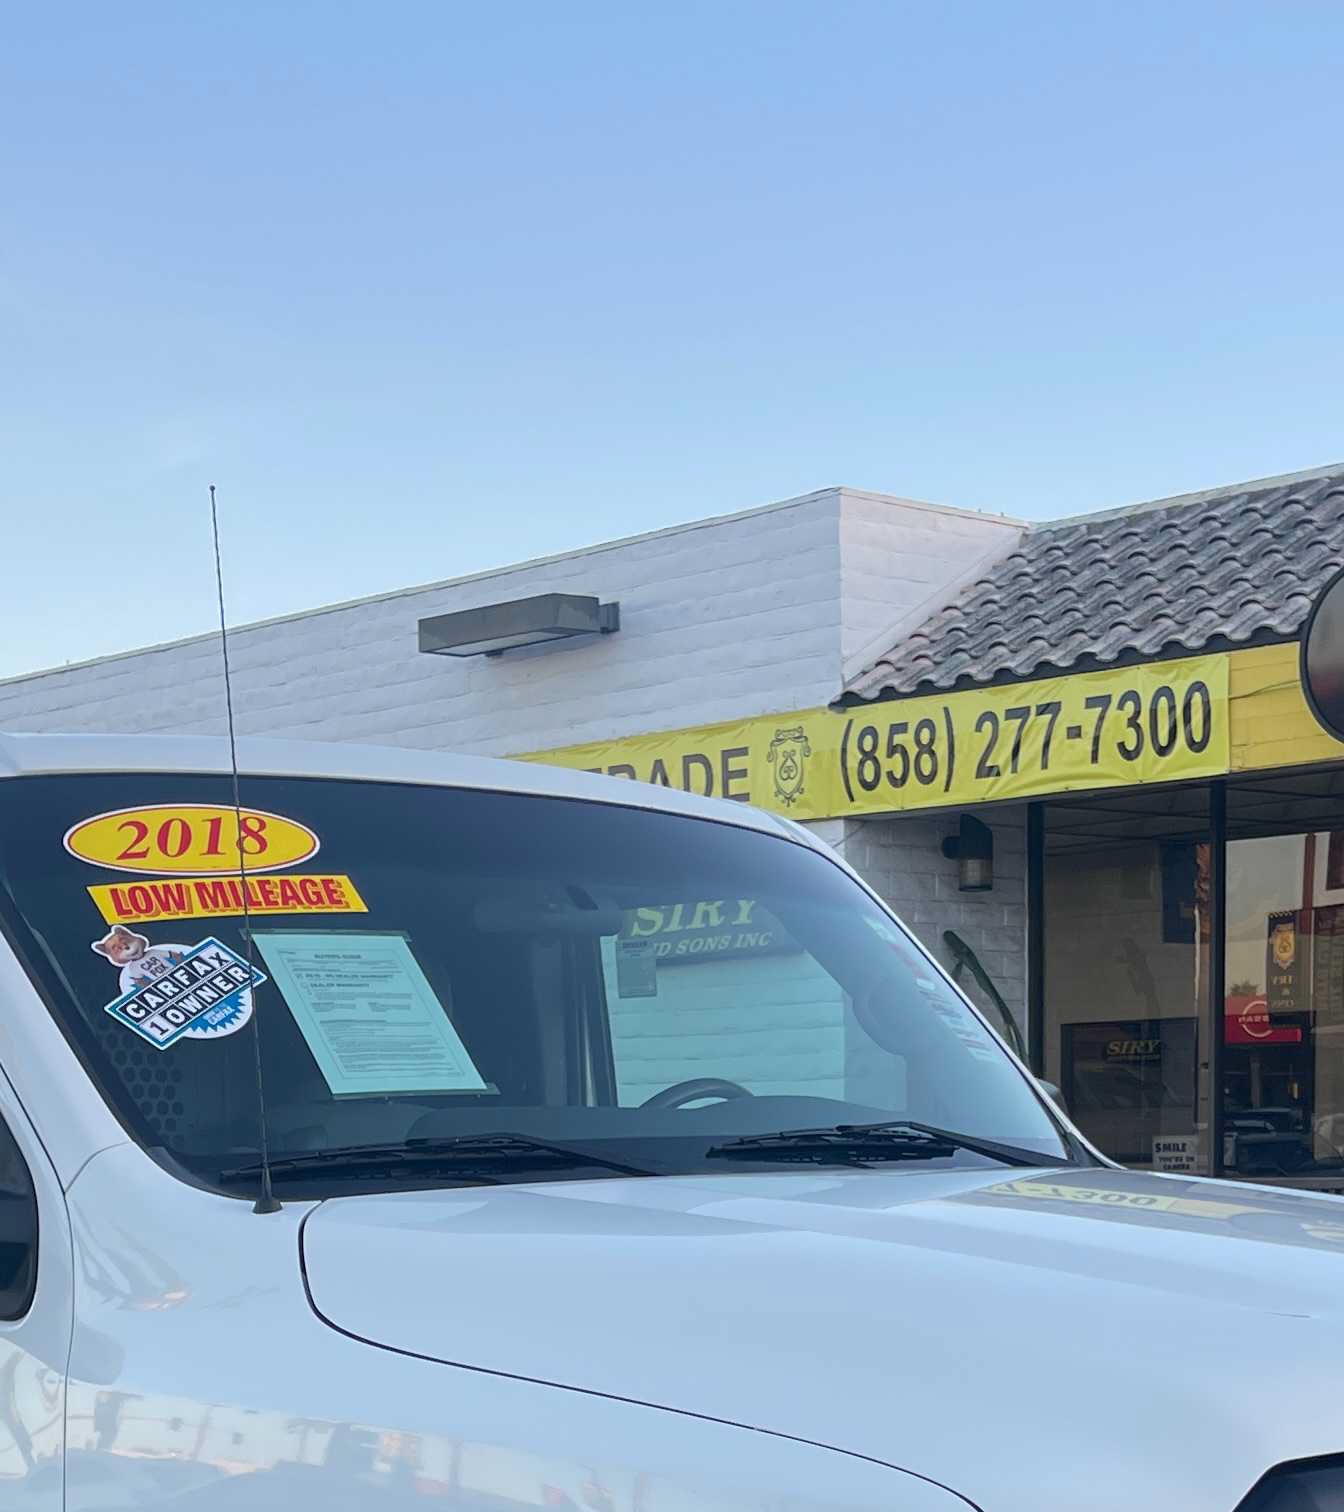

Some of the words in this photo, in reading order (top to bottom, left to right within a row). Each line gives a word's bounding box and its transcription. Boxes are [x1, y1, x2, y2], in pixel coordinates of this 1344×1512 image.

[839, 706, 956, 802] (858)
[974, 680, 1213, 781] 277-7300
[578, 746, 751, 803] ADE
[115, 815, 270, 861] 2018
[109, 880, 194, 919] LOW
[196, 877, 347, 914] MILEAGE
[630, 899, 757, 937] SIRY
[140, 956, 161, 971] CAR
[675, 935, 731, 956] SONS
[734, 931, 773, 949] INC
[126, 951, 229, 1019] CARFAX
[149, 1020, 170, 1036] 1
[166, 965, 251, 1024] OWNER
[1107, 1040, 1161, 1056] SIRY
[1155, 1142, 1188, 1153] SMILE
